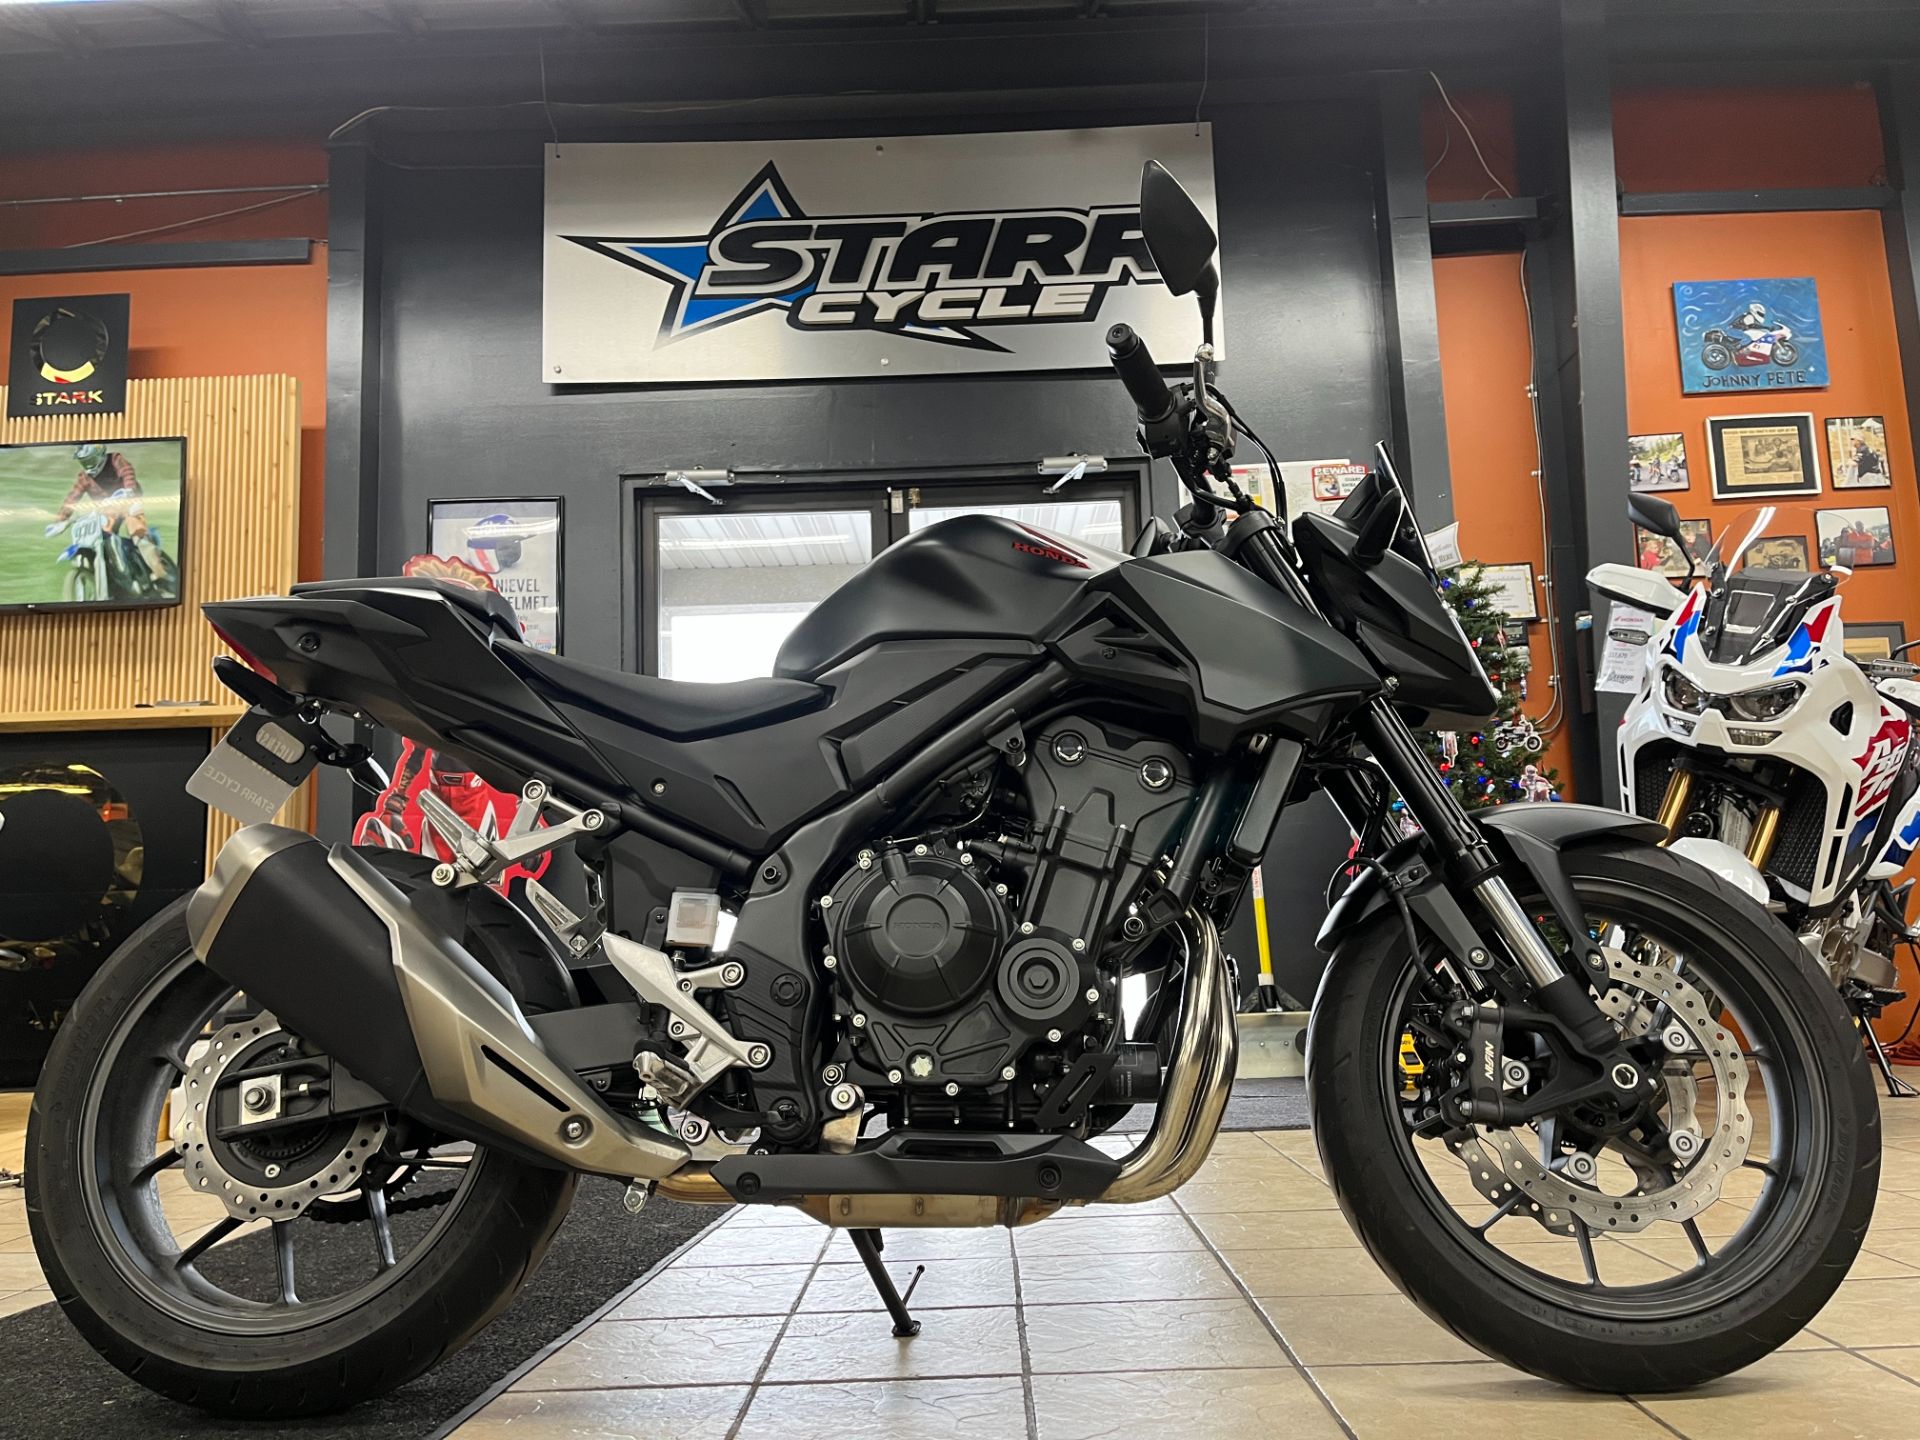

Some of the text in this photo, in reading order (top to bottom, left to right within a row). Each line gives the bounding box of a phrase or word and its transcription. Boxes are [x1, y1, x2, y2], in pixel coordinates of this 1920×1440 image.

[798, 284, 1095, 324] CYCLE
[1702, 370, 1807, 388] JOHNNY PETE
[1012, 541, 1091, 570] HONDA
[495, 578, 540, 593] NIEVEL
[508, 596, 548, 610] ELMET
